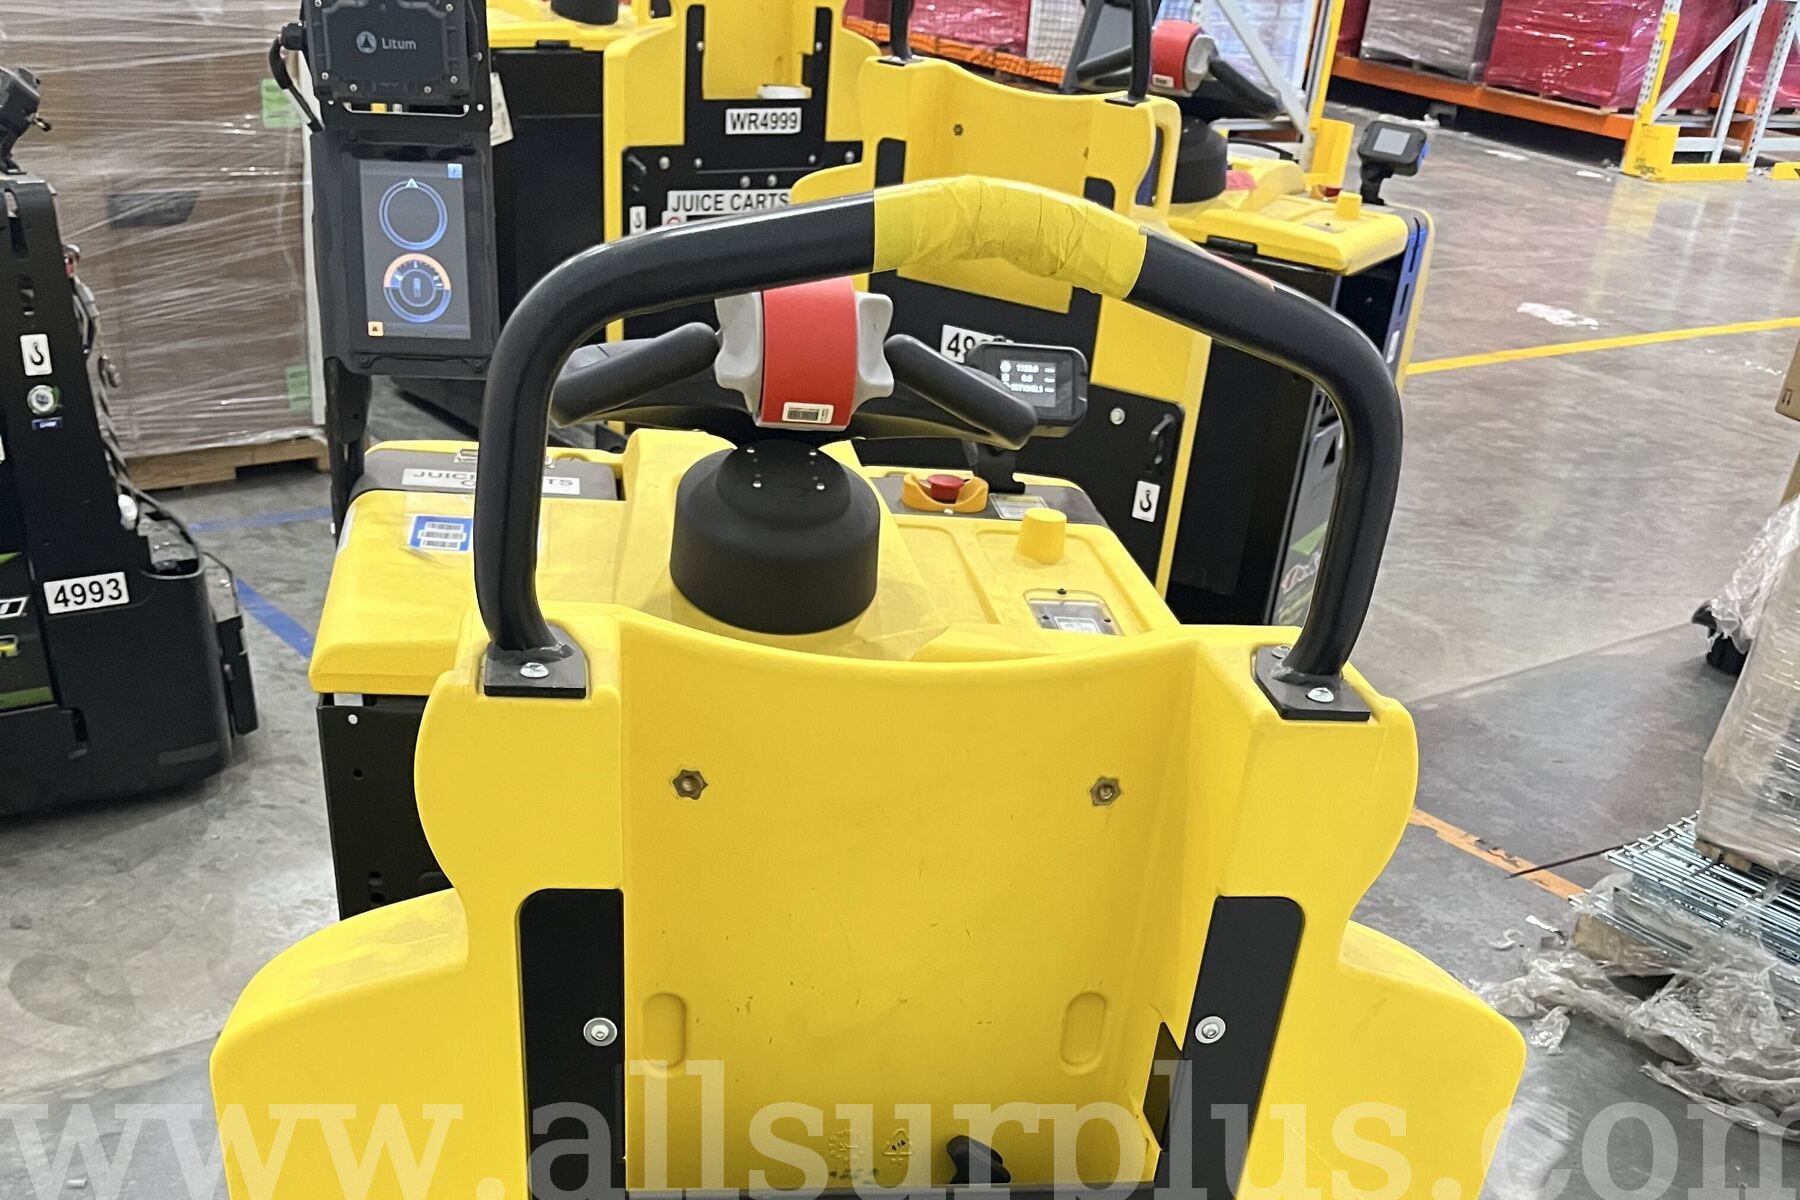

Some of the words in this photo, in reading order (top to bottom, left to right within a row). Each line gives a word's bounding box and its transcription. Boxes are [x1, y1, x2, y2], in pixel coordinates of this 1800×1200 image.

[381, 37, 417, 50] Litum
[729, 111, 799, 131] WR4999
[671, 193, 724, 213] JUICE
[730, 191, 789, 211] CARTS
[413, 471, 476, 480] JUIC
[53, 578, 122, 608] 4993
